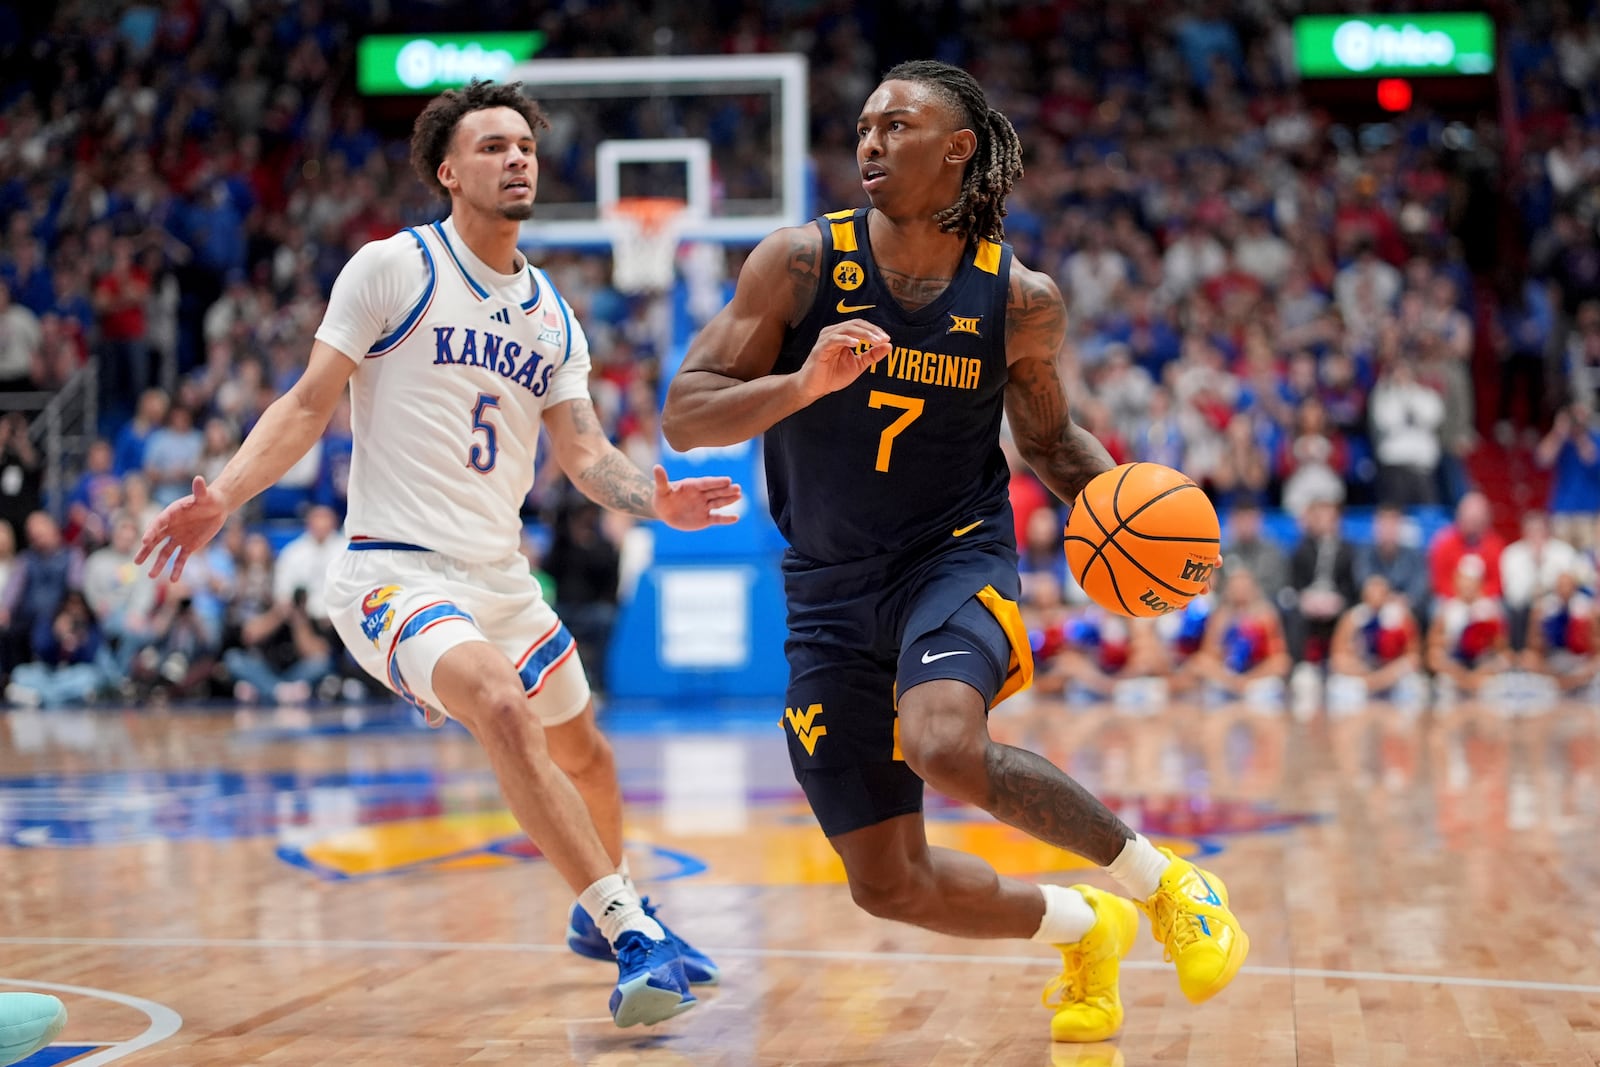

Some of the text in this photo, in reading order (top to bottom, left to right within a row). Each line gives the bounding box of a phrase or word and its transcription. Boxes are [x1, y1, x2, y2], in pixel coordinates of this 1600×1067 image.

[838, 271, 858, 285] 44
[840, 265, 858, 273] WEST
[948, 314, 981, 335] XII
[433, 326, 554, 398] KANSAS
[886, 346, 982, 390] VIRGINIA
[466, 391, 500, 475] 5
[868, 389, 925, 473] 7
[366, 613, 380, 632] KU
